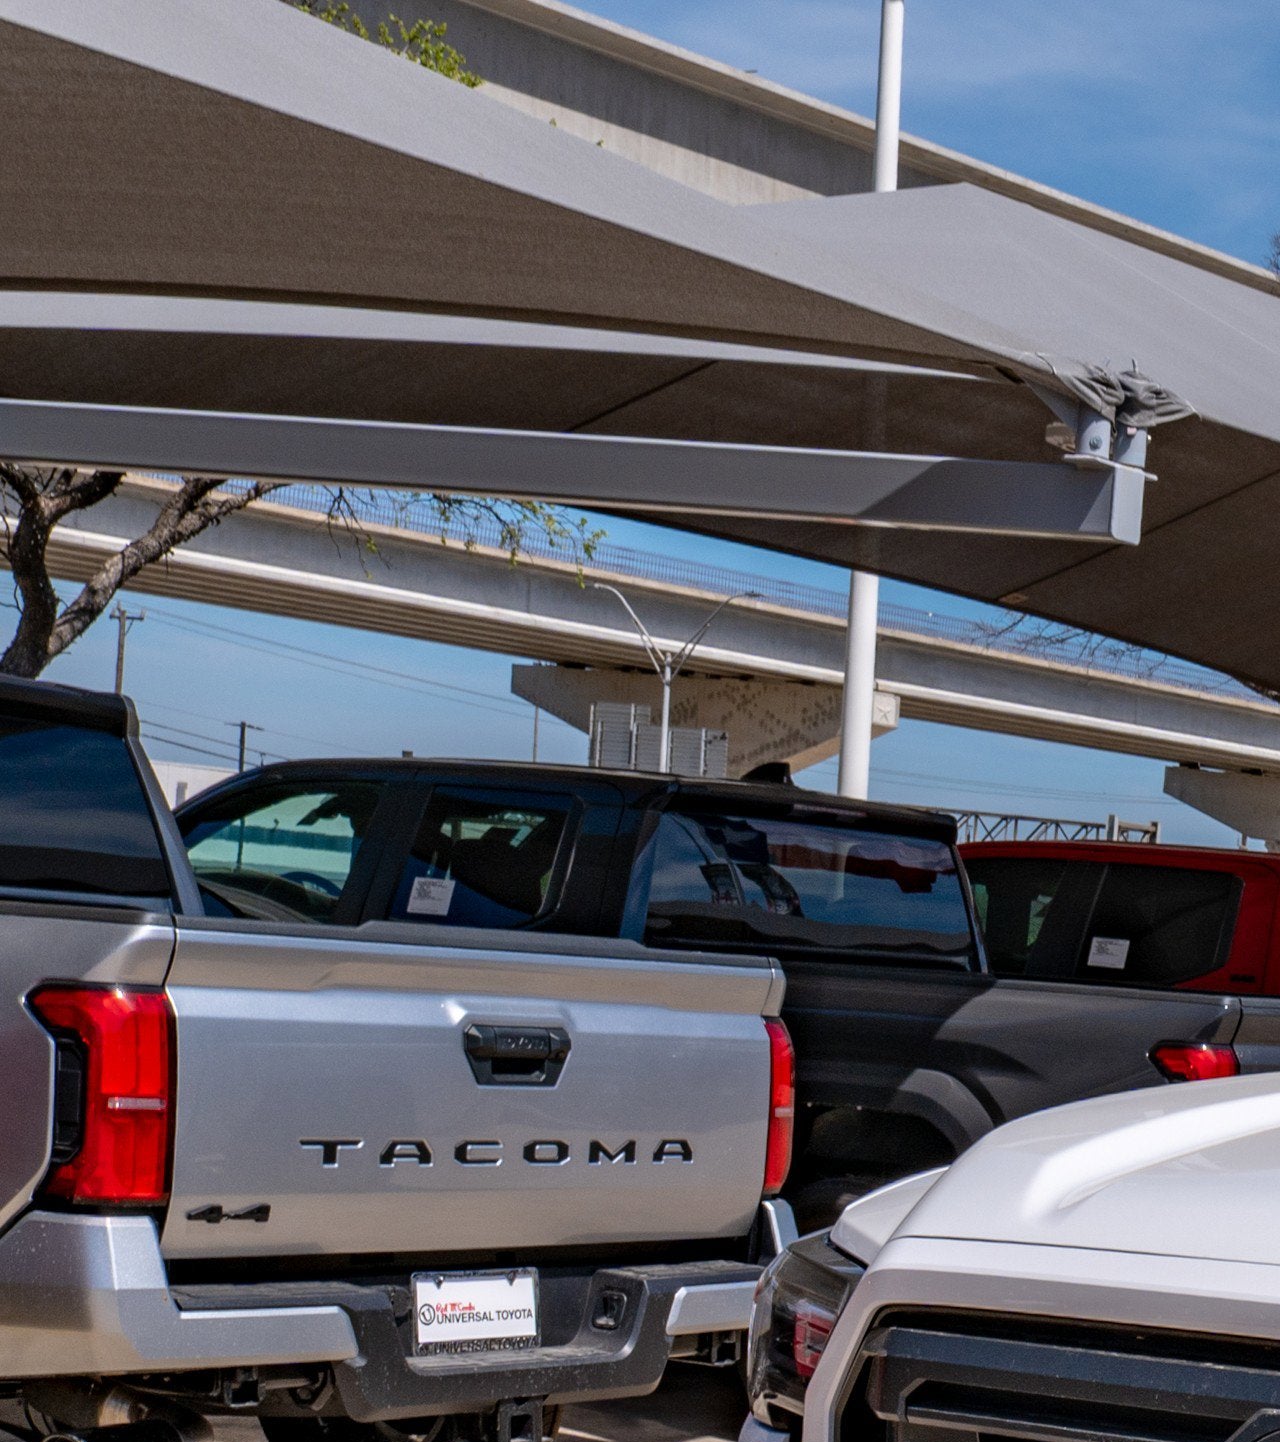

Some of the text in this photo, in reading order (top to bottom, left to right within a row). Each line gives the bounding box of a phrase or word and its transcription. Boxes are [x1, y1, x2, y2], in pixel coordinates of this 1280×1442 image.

[299, 1138, 695, 1168] TACOMA
[436, 1308, 533, 1325] UNIVERSAL TOYOTA
